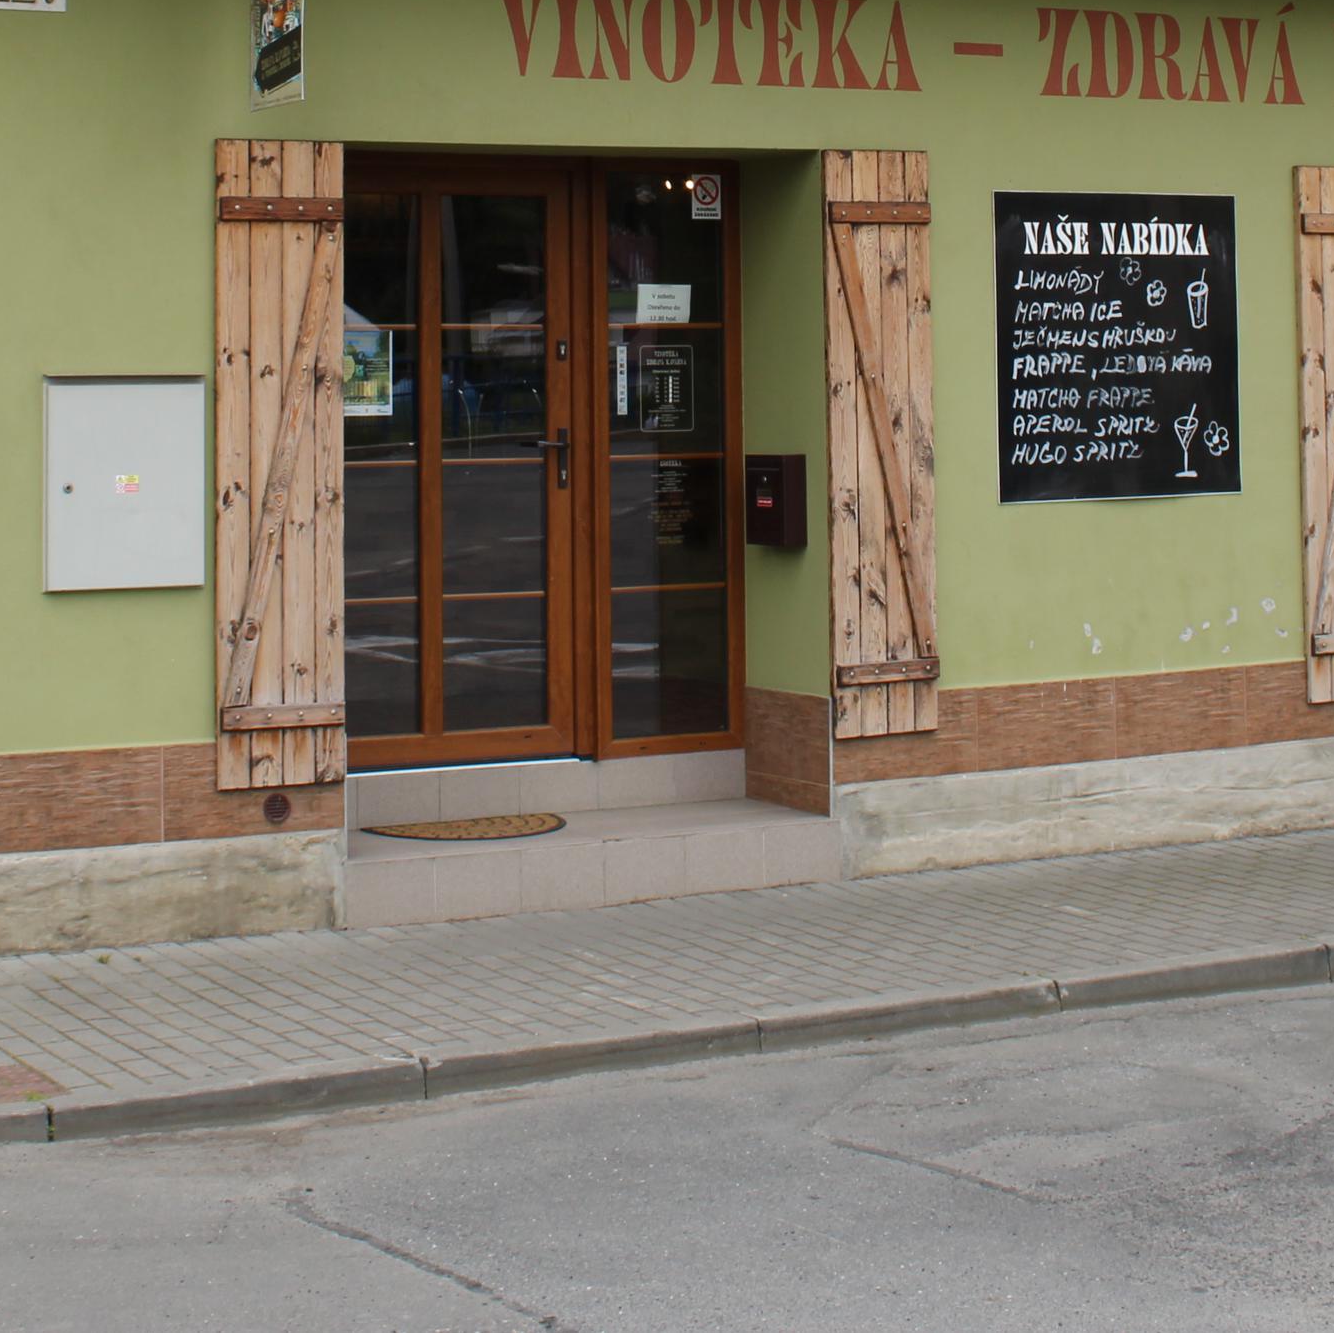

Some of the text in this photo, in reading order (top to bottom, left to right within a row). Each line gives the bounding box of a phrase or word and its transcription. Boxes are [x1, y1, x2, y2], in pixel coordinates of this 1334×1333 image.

[1035, 1, 1306, 106] ZDRAVÁ
[1023, 214, 1210, 255] NAŠE NABÍDKA
[1014, 265, 1105, 295] LIMONÁDY
[1014, 299, 1123, 324] MATCHA ICE
[1012, 387, 1081, 410] MATCHA
[1013, 413, 1160, 437] APEROL SPRITZ
[1011, 439, 1144, 465] HUGO SPRITZ
